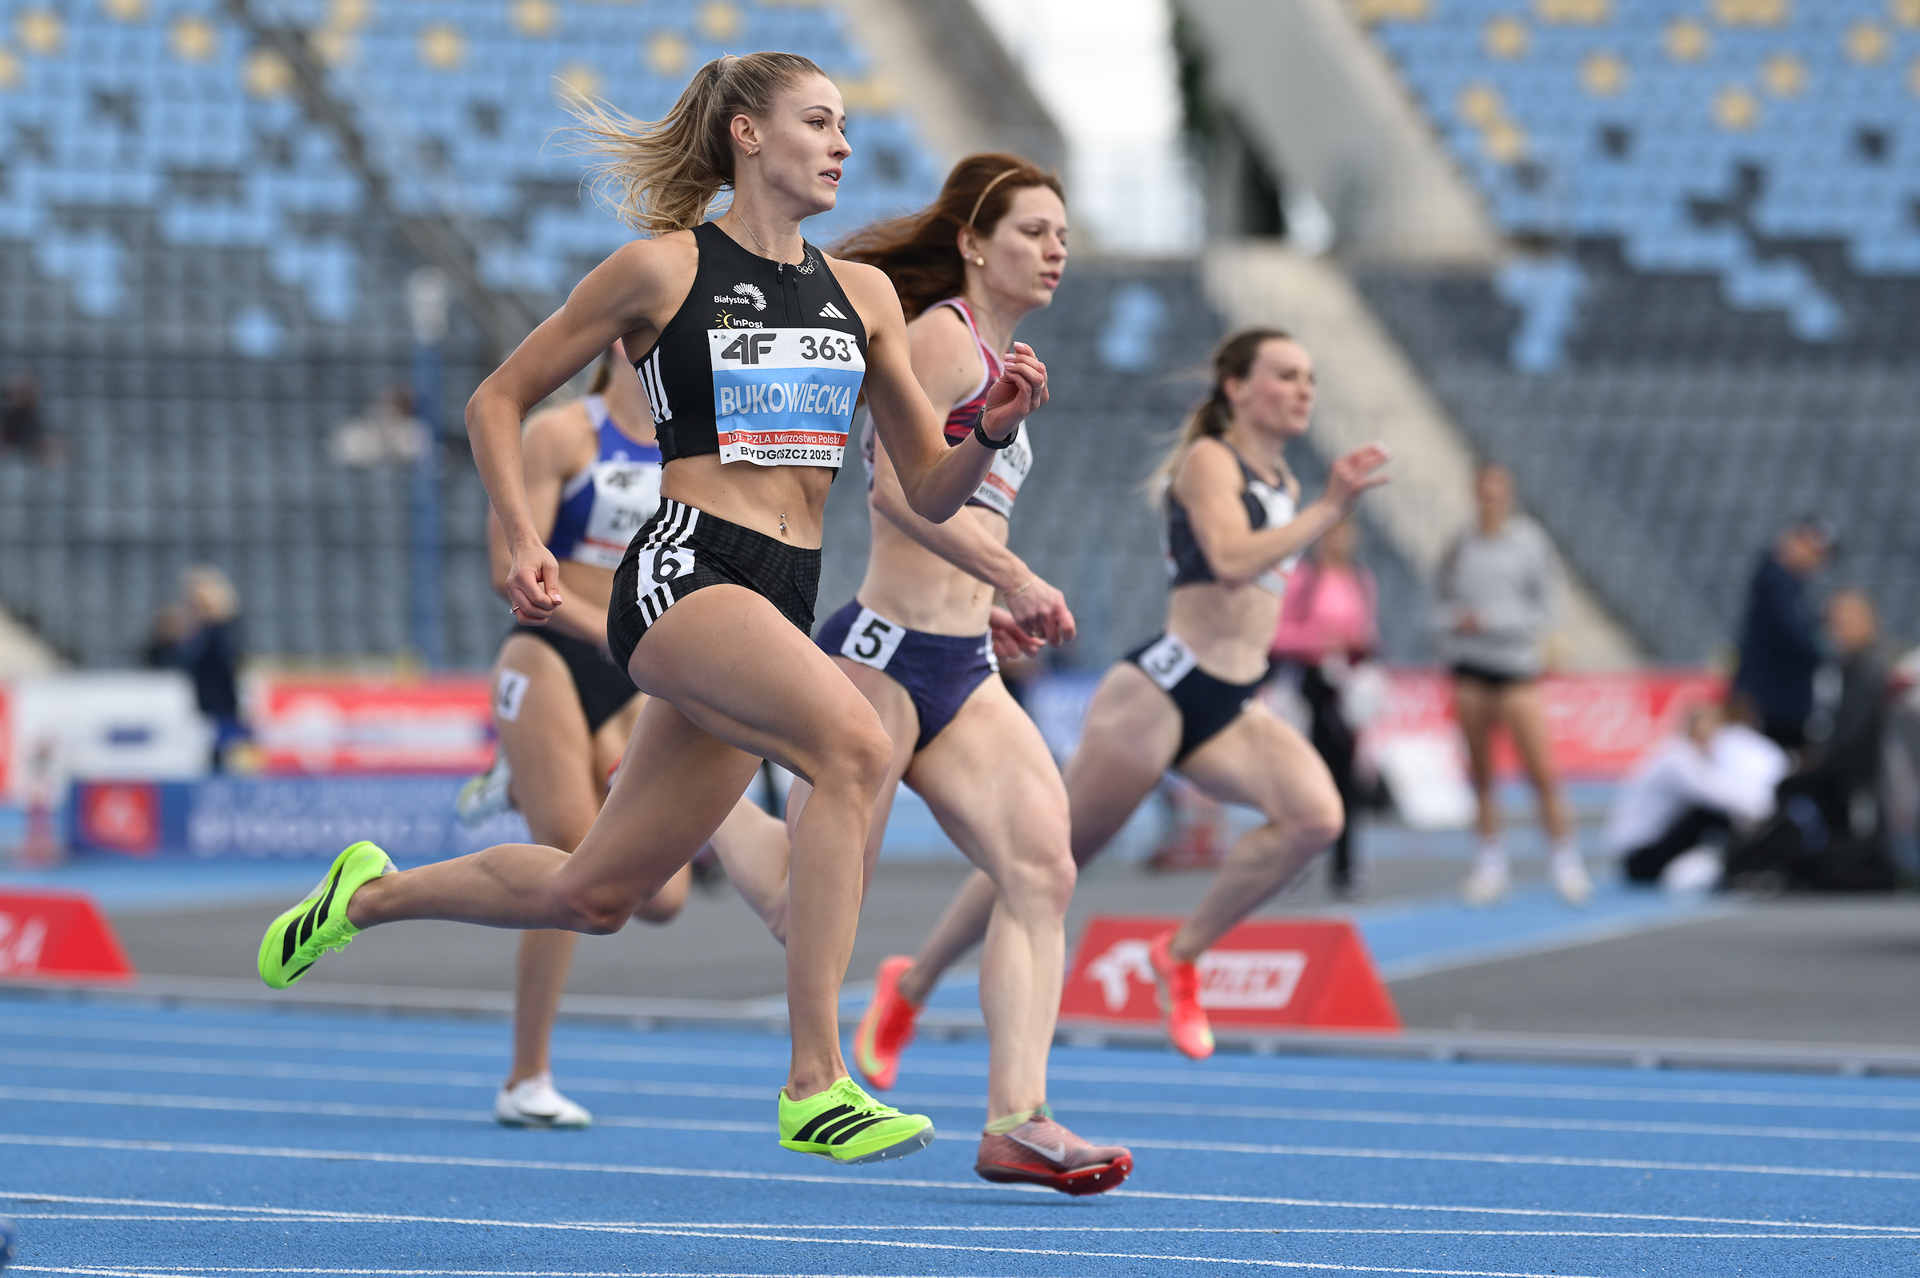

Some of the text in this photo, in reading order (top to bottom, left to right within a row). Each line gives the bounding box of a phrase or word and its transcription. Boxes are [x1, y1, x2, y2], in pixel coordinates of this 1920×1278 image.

[714, 293, 751, 306] Białystok
[733, 318, 764, 329] InPost
[721, 333, 852, 365] 4F 363
[720, 383, 852, 417] BUKOWIECKA
[740, 446, 832, 461] BYDGOSZCZ 2025
[747, 434, 772, 445] PZLA
[775, 434, 818, 444] Mistrzostwa
[818, 435, 841, 445] Polski
[652, 546, 682, 584] 6
[855, 618, 892, 659] 5
[1153, 643, 1184, 675] 3
